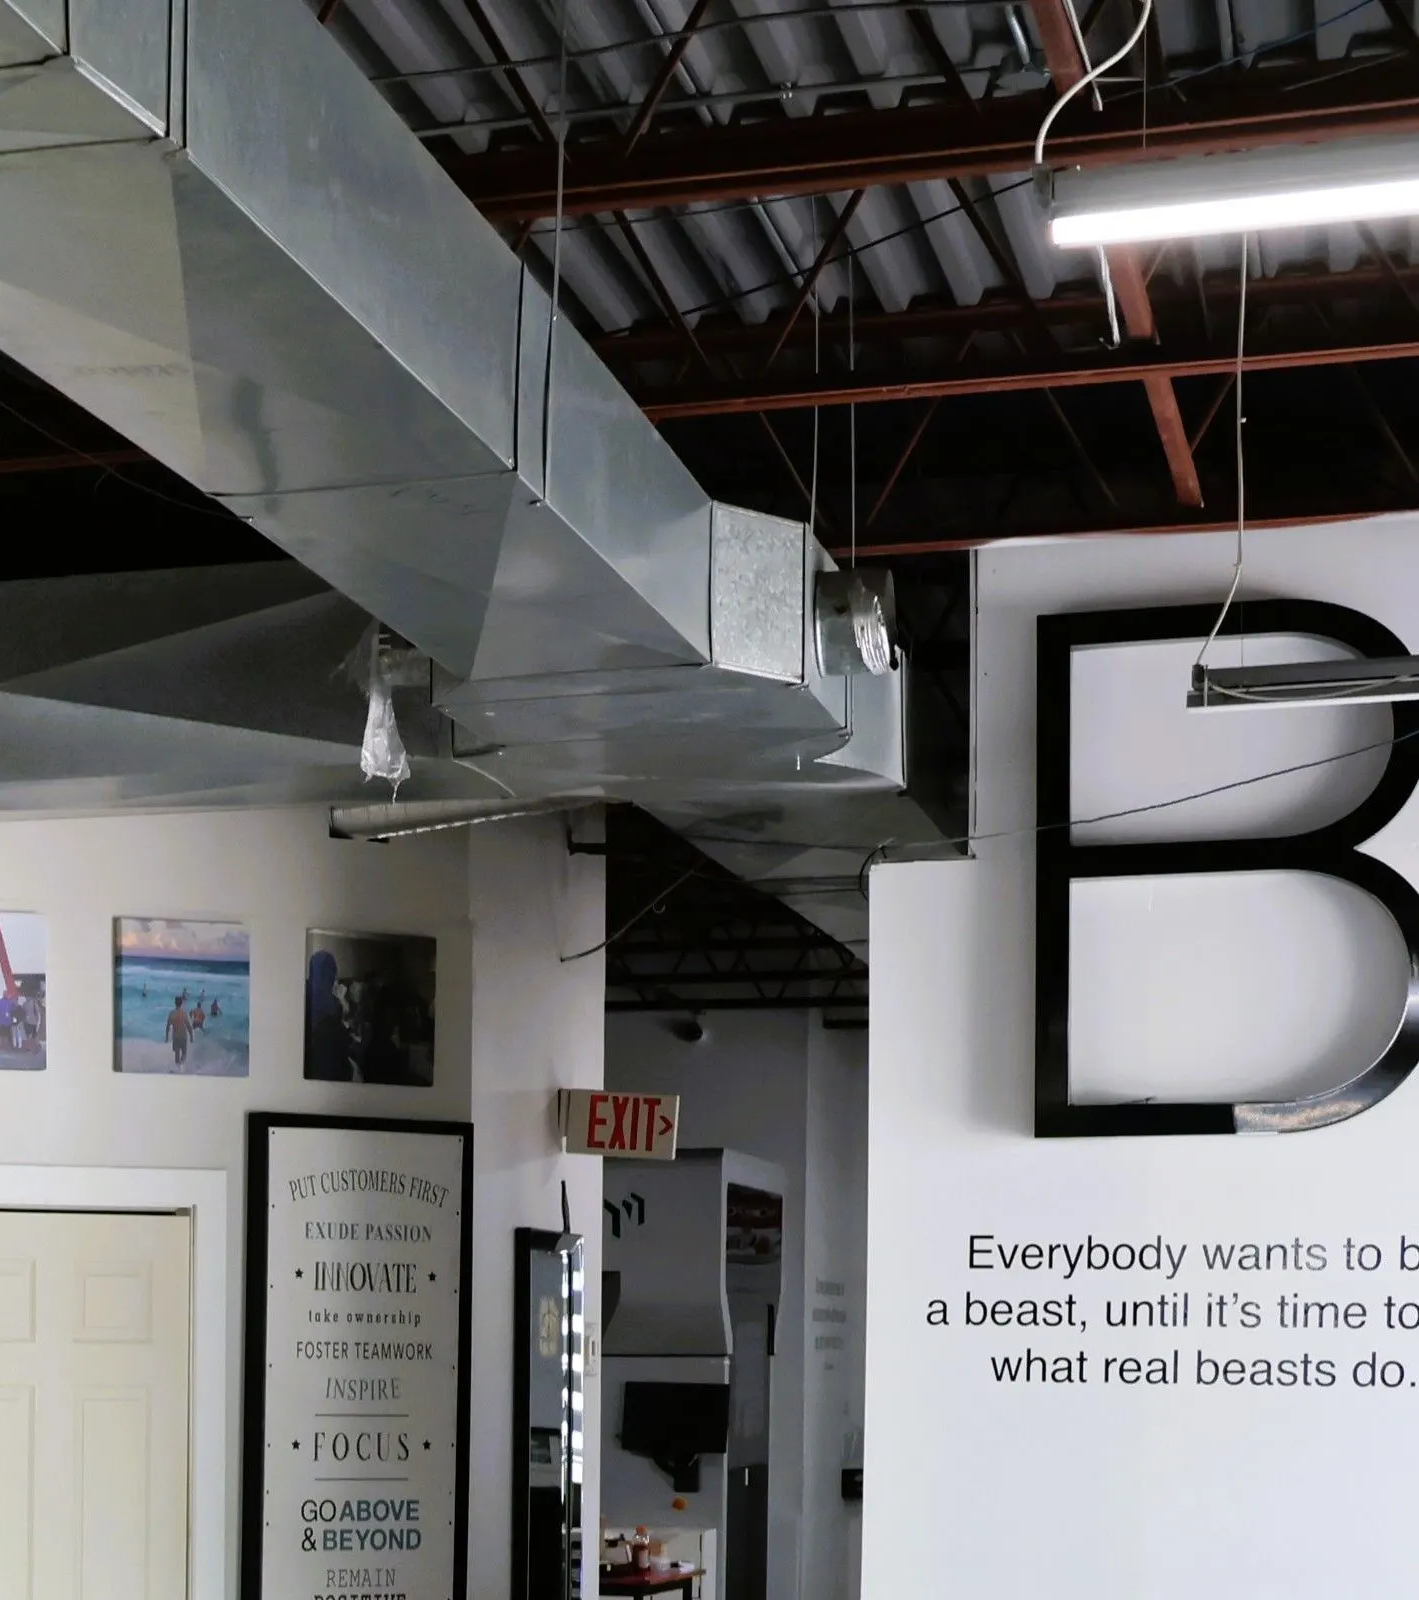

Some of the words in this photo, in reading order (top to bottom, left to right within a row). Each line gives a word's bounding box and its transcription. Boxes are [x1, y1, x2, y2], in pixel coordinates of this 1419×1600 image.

[587, 1094, 662, 1151] EXIT
[289, 1175, 317, 1203] PUT
[321, 1169, 405, 1196] CUSTOMERS
[409, 1176, 449, 1208] FIRST
[305, 1220, 359, 1242] EXUDE
[366, 1223, 432, 1244] PASSION
[969, 1235, 1187, 1279] Everybody
[1202, 1237, 1328, 1271] wants
[1343, 1237, 1382, 1271] to
[314, 1261, 418, 1293] INNOVATE
[309, 1309, 339, 1323] take
[346, 1310, 421, 1328] ownership
[926, 1300, 949, 1326] a
[965, 1291, 1086, 1333] beast,
[1106, 1292, 1189, 1327] until
[1277, 1293, 1367, 1329] time
[1384, 1295, 1419, 1330] to
[296, 1341, 348, 1360] FOSTER
[355, 1342, 433, 1361] TEAMWORK
[991, 1348, 1088, 1384] what
[1104, 1350, 1178, 1385] real
[1196, 1350, 1336, 1387] beasts
[1352, 1351, 1416, 1388] do.
[326, 1377, 400, 1401] INSPIRE
[313, 1432, 410, 1462] FOCUS
[301, 1500, 336, 1523] GO
[339, 1500, 420, 1522] ABOVE
[301, 1529, 318, 1552] &
[322, 1528, 422, 1551] BEYOND
[326, 1568, 396, 1589] REMAIN
